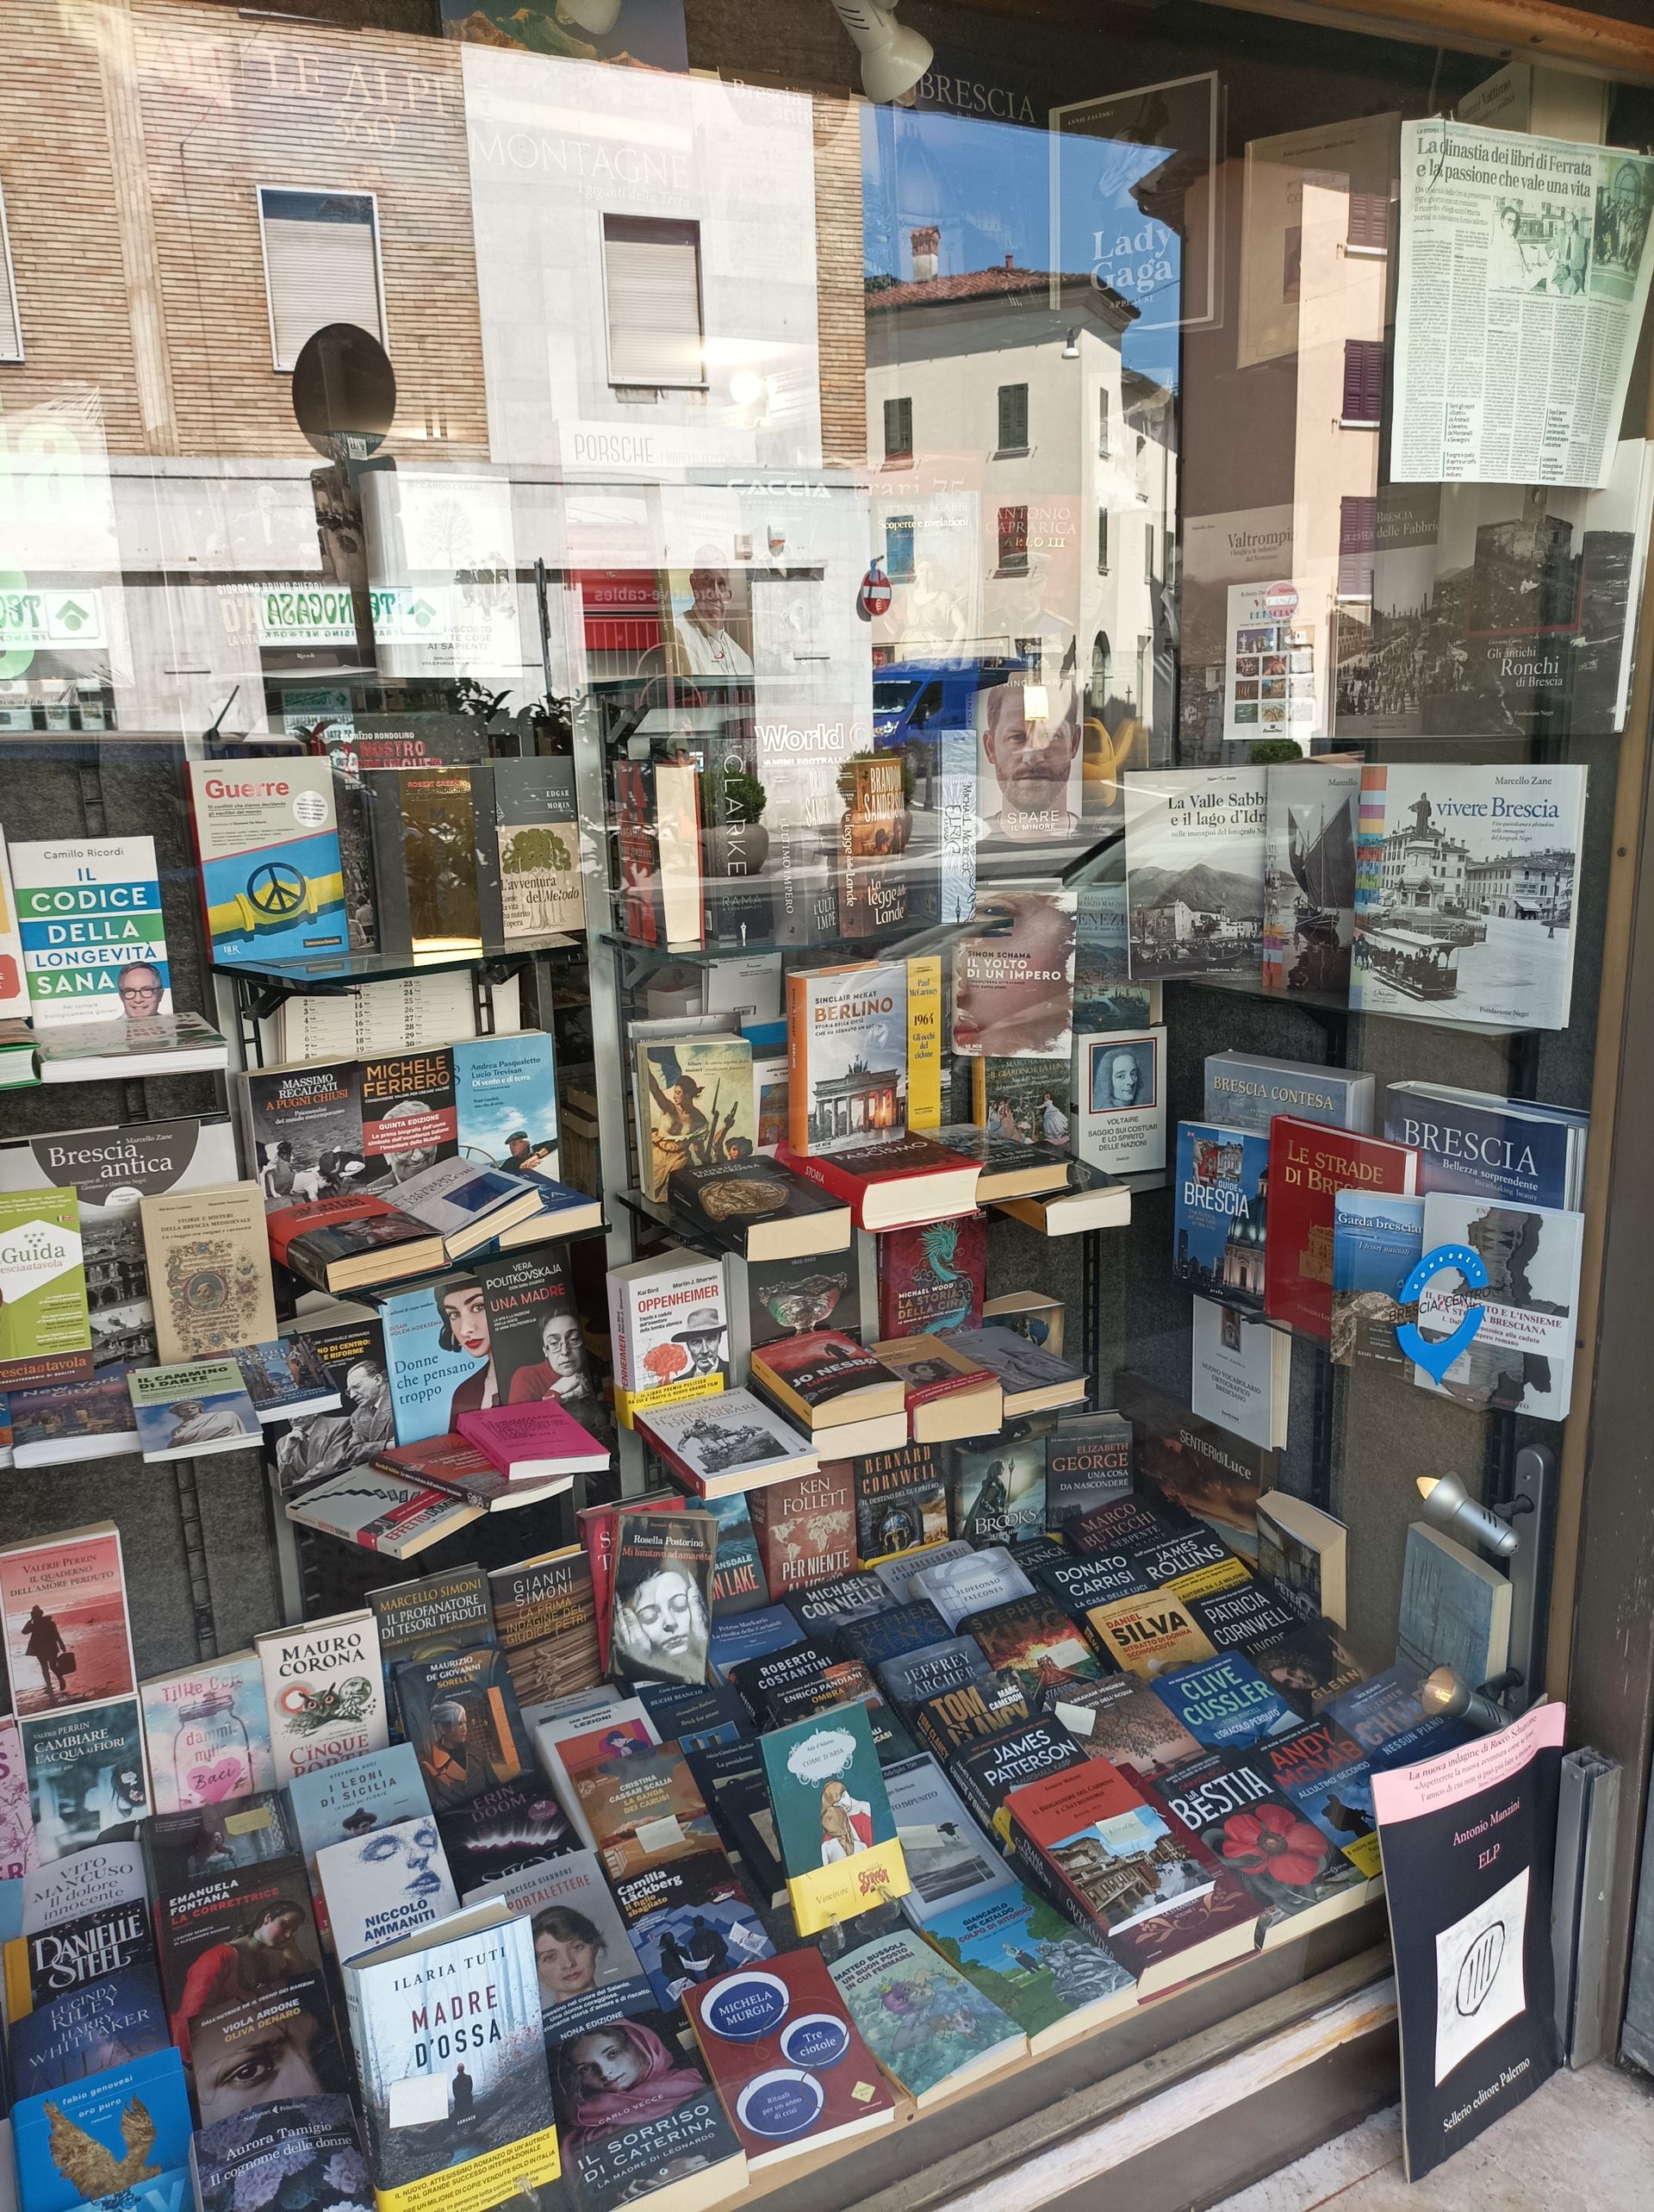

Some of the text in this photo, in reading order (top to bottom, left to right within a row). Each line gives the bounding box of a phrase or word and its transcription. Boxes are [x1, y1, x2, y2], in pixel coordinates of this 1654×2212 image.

[266, 47, 449, 119] LE ALPI
[919, 72, 1036, 123] BRESCIA
[469, 128, 689, 190] MONTAGNE
[1417, 138, 1592, 177] La dinastia dei libri di Ferrata
[1416, 159, 1591, 198] e la passione che vale una vita
[1092, 222, 1175, 261] Lady
[1091, 257, 1172, 293] Gaga
[1228, 526, 1299, 548] Valtrompia
[1487, 645, 1537, 661] Gli antichi
[1500, 657, 1559, 678] Ronchi
[1516, 674, 1563, 688] di Brescia
[359, 740, 426, 757] NOSTRO
[754, 722, 844, 754] World
[205, 778, 289, 800] Guerre
[545, 788, 569, 797] EDGAR
[1495, 776, 1552, 785] Marcello Zane
[547, 801, 570, 810] MORIN
[723, 754, 748, 876] CLARKE
[1168, 795, 1224, 810] La Valle
[1436, 797, 1559, 819] vivere Brescia
[1007, 810, 1060, 825] SPARE
[1021, 822, 1055, 831] MINORE
[1171, 810, 1225, 826] e il lago
[44, 847, 124, 860] Camillo Ricordi
[78, 867, 96, 882] IL
[500, 876, 557, 890] L'avventura
[31, 886, 148, 913] CODICE
[525, 888, 580, 904] del Metodo
[48, 919, 140, 944] DELLA
[35, 941, 157, 968] LONGEVITÀ
[967, 950, 1031, 959] SIMON SCHAMA
[967, 958, 1028, 969] IL VOLTO
[37, 970, 115, 995] SANA
[967, 969, 1061, 981] DI UN IMPERO
[814, 996, 893, 1023] BERLINO
[815, 990, 877, 1005] SINCLAIR McKAY
[913, 1013, 935, 1025] 1964
[282, 1074, 333, 1089] MASSIMO
[367, 1056, 446, 1081] MICHELE
[278, 1081, 338, 1100] RECALCATI
[363, 1071, 451, 1097] FERRERO
[1214, 1075, 1334, 1111] BRESCIA CONTESA
[266, 1089, 348, 1111] A PUGNI CHIUSI
[1088, 1129, 1113, 1137] SAGGIO
[1107, 1117, 1139, 1125] VOLTAIRE
[1098, 1143, 1119, 1151] DELLE
[1118, 1132, 1144, 1141] SPIRITO
[1402, 1118, 1539, 1177] BRESCIA
[48, 1141, 138, 1168] Brescia
[100, 1155, 173, 1179] antica
[1286, 1140, 1384, 1185] LE STRADE
[1442, 1158, 1538, 1192] Bellezza sorprendente
[1185, 1181, 1249, 1219] BRESCIA
[486, 1263, 563, 1290] POLITKOVSKAJA
[512, 1262, 532, 1273] VERA
[1412, 1252, 1483, 1290] CONSORZIO
[673, 1280, 689, 1290] Martin
[695, 1274, 718, 1284] Sherwin
[899, 1282, 954, 1299] MICHAEL WOOD
[490, 1283, 565, 1312] UNA MADRE
[637, 1285, 719, 1313] OPPENHEIMER
[1388, 1287, 1491, 1323] BRESCIA CENTRO
[394, 1354, 438, 1374] Donne
[396, 1360, 476, 1389] che pensano
[399, 1385, 442, 1405] troppo
[865, 1444, 932, 1474] BERNARD
[1077, 1442, 1129, 1455] ELIZABETH
[1052, 1453, 1129, 1472] GEORGE
[799, 1477, 830, 1494] KEN
[861, 1463, 937, 1495] CORNWELL
[782, 1489, 848, 1516] FOLLETT
[975, 1508, 1036, 1535] BROOKS
[633, 1534, 704, 1548] Rosella Postorino
[513, 1567, 573, 1595] GIANNI
[1054, 1555, 1128, 1584] DONATO
[514, 1580, 574, 1607] SIMONI
[1069, 1572, 1135, 1598] CARRISI
[1204, 1591, 1272, 1623] PATRICIA
[1110, 1610, 1189, 1647] SILVA
[1213, 1608, 1294, 1645] CORNWELL
[1181, 1665, 1242, 1701] CLIVE
[1183, 1680, 1274, 1725] CUSSLER
[994, 1729, 1051, 1765] JAMES
[1269, 1727, 1337, 1770] ANDY
[984, 1739, 1078, 1785] PATTERSON
[1272, 1740, 1363, 1791] MCNAB
[193, 1767, 235, 1790] Baci
[1168, 1766, 1275, 1830] BESTIA
[1452, 1797, 1521, 1847] Antonio Manzini
[1477, 1842, 1501, 1871] ELP
[394, 1947, 507, 1992] ILARIA TUTI
[222, 1999, 300, 2034] VIOLA ARDONE
[412, 1985, 499, 2034] MADRE
[718, 1990, 773, 2017] MICHELA
[725, 2002, 774, 2027] MURGIA
[415, 2017, 502, 2069] D'OSSA
[799, 2036, 836, 2058] ciotole
[802, 2028, 824, 2044] Tre
[1443, 2056, 1531, 2134] Sellerio editore Palermo
[226, 2122, 333, 2162] Aurora Tamigio
[576, 2104, 710, 2171] IL SORRISO
[583, 2118, 718, 2184] DI CATERINA
